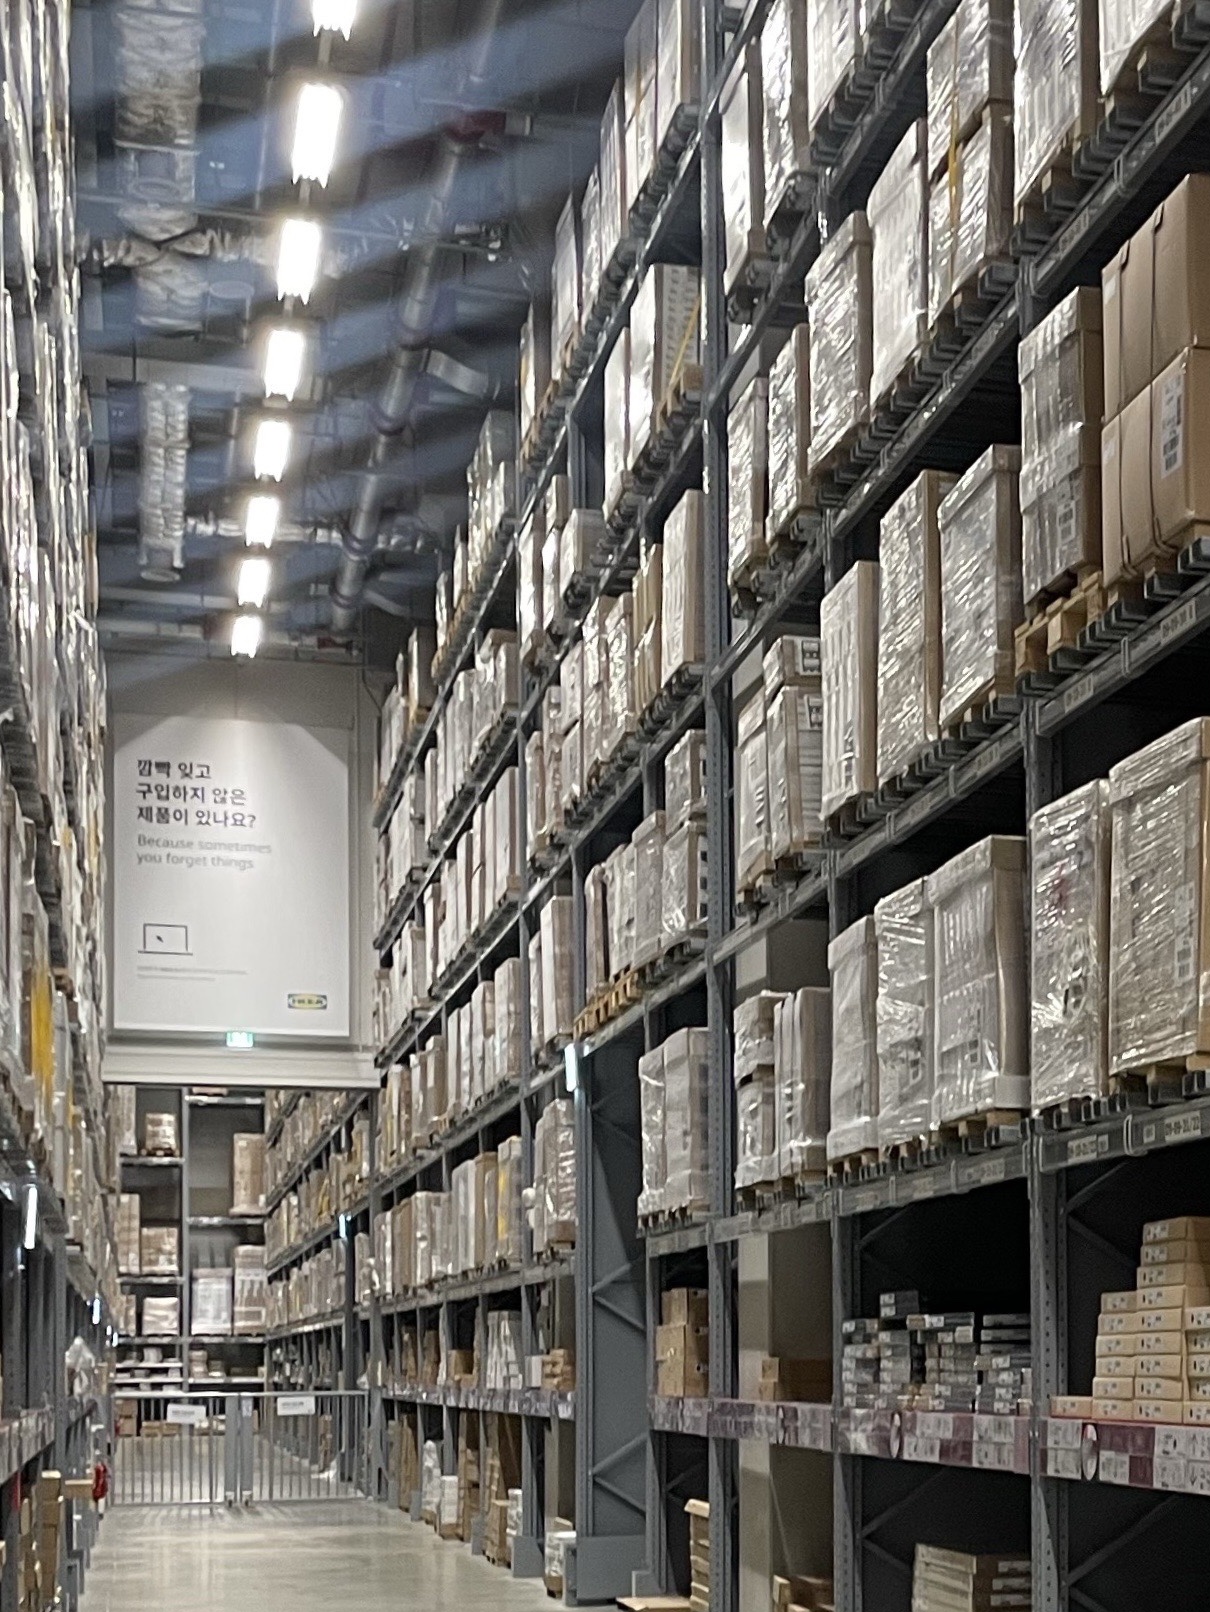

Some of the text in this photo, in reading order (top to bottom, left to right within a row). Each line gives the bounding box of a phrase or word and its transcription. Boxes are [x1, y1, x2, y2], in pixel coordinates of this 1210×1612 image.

[137, 759, 212, 780] 깜빡 잊고
[136, 782, 247, 806] 구입하지 않은
[137, 805, 256, 828] 제품이 있나요?
[137, 833, 272, 855] Because sometimes
[137, 851, 254, 871] you forget things
